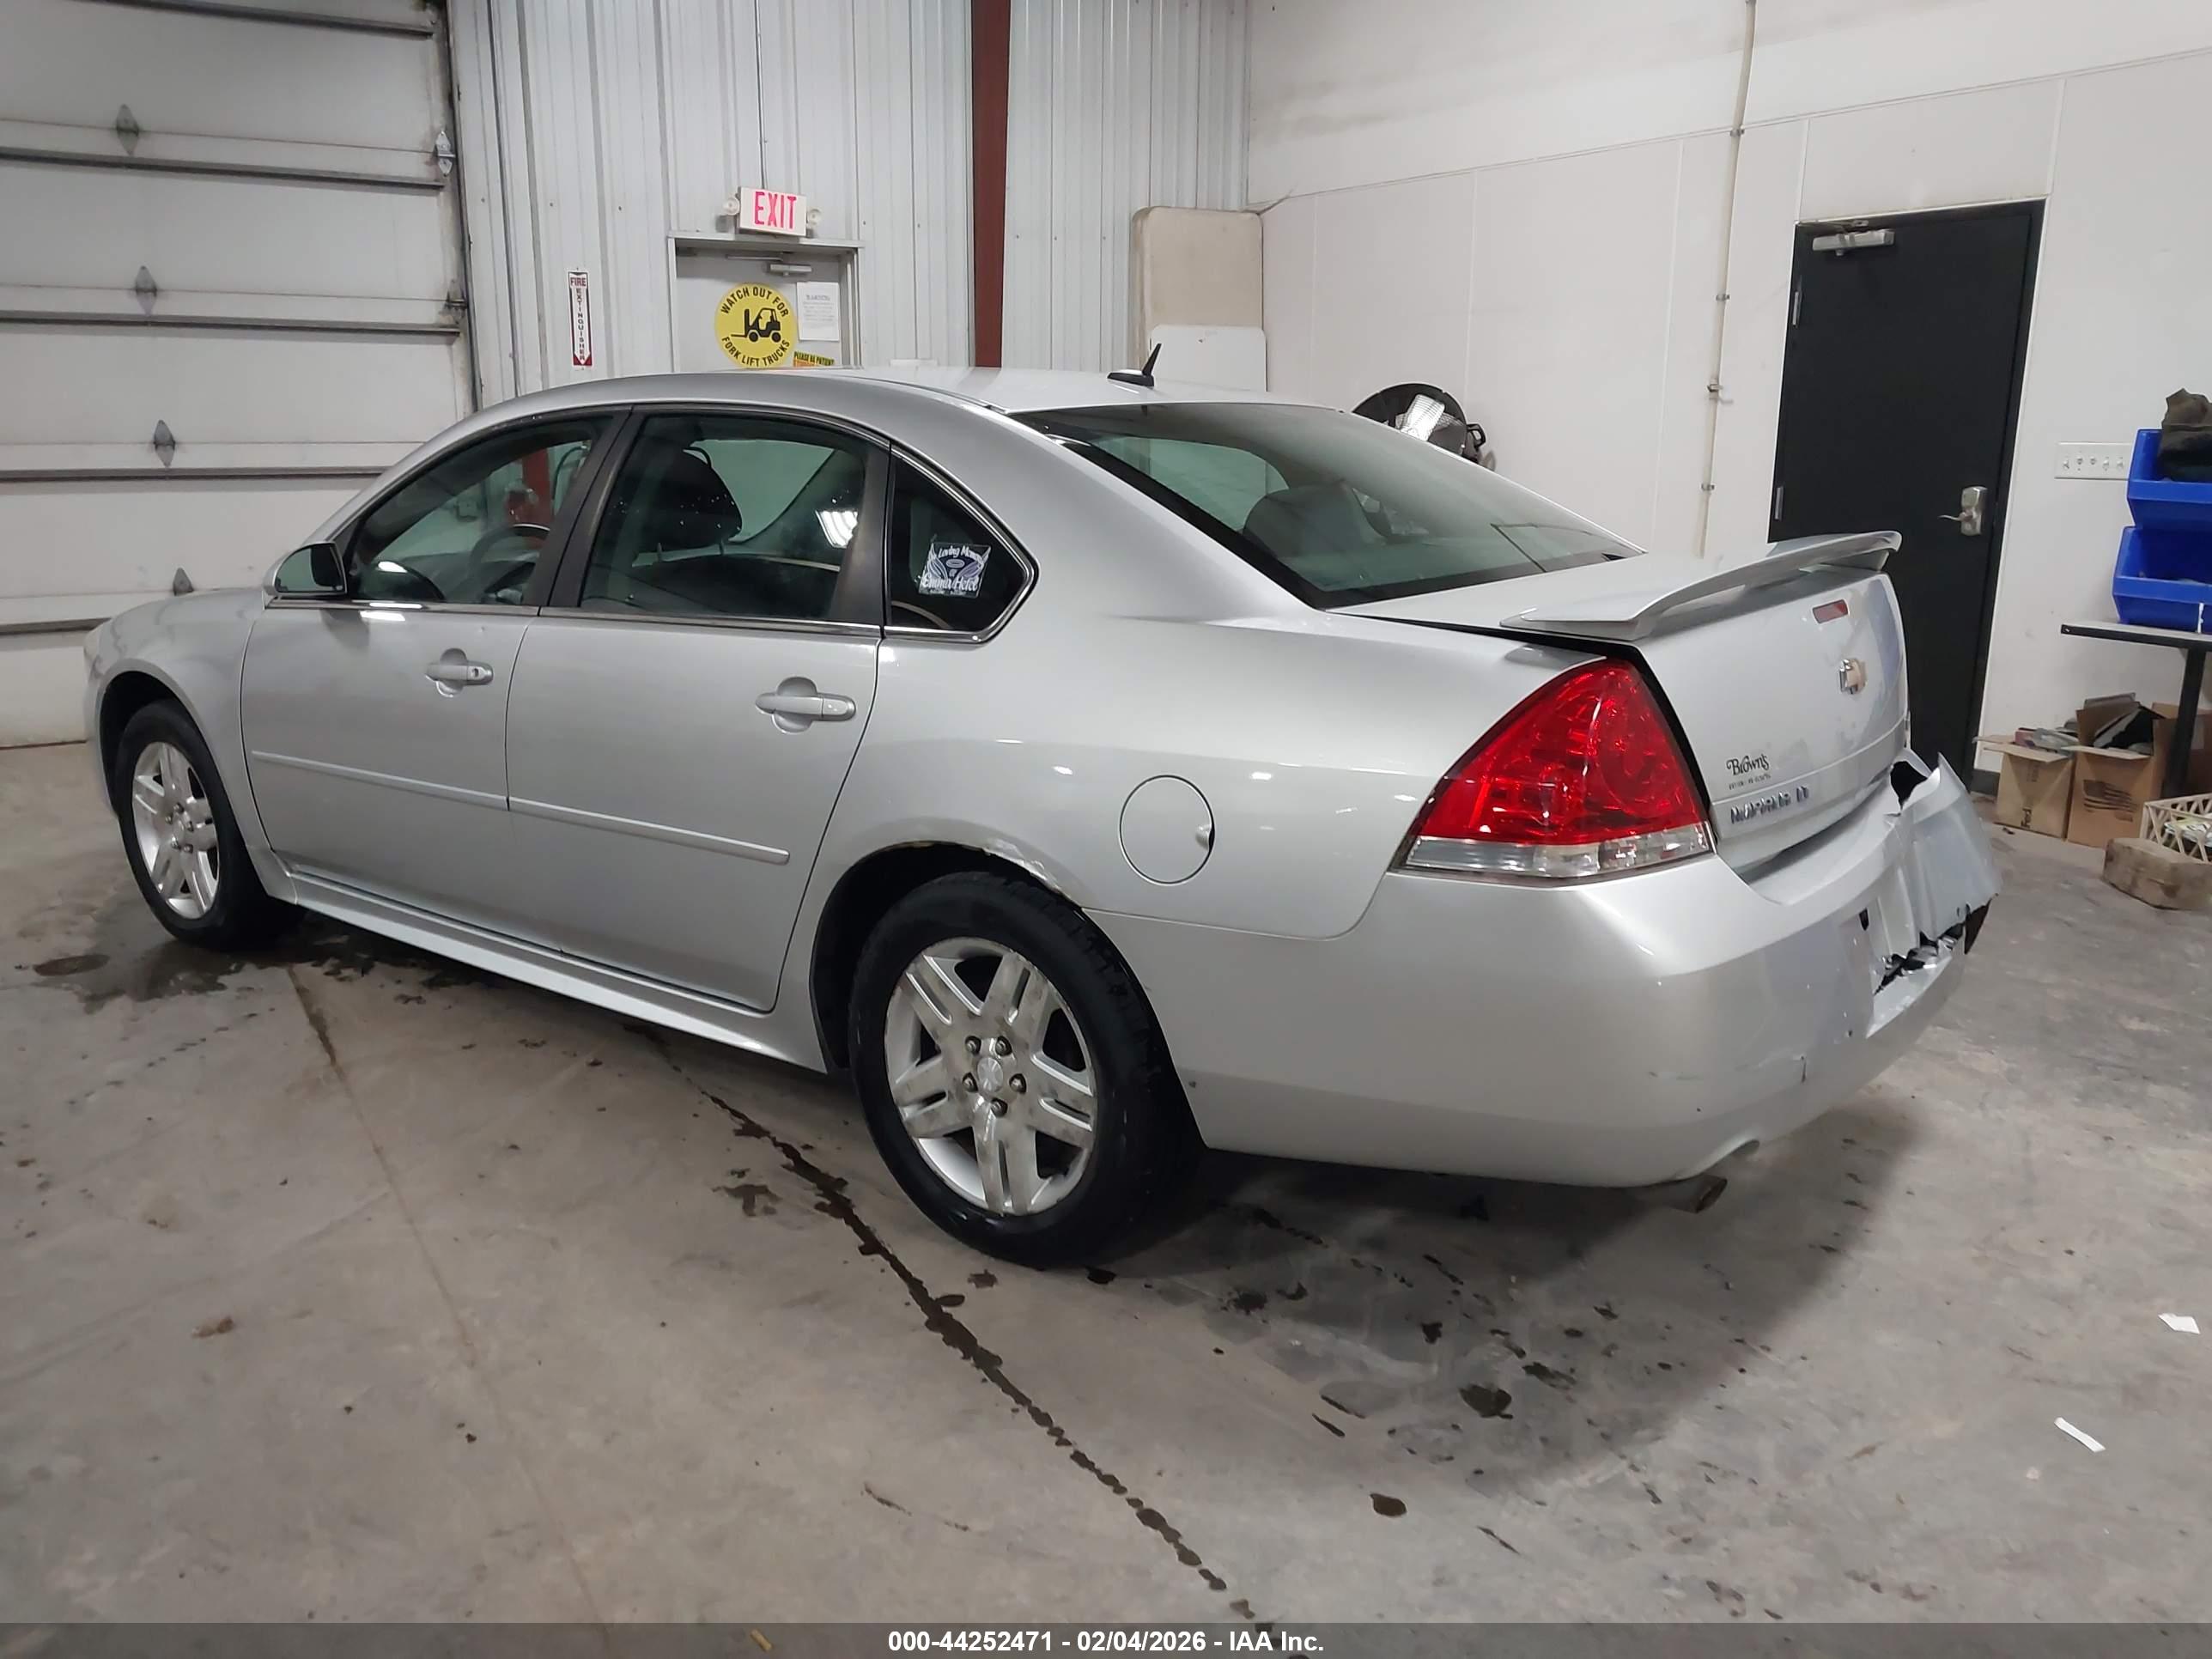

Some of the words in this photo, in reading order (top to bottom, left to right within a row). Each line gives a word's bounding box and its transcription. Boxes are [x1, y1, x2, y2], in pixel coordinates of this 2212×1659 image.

[754, 191, 797, 229] EXIT
[570, 276, 586, 287] FIRE
[720, 287, 750, 314] WATCH
[752, 287, 773, 300] OUT
[772, 296, 789, 317] FOR
[575, 288, 586, 361] EXTINGUISHER
[722, 336, 742, 359] FORK
[741, 355, 760, 367] LIFT
[763, 340, 790, 367] TRUCKS
[1726, 753, 1769, 775] Brown's
